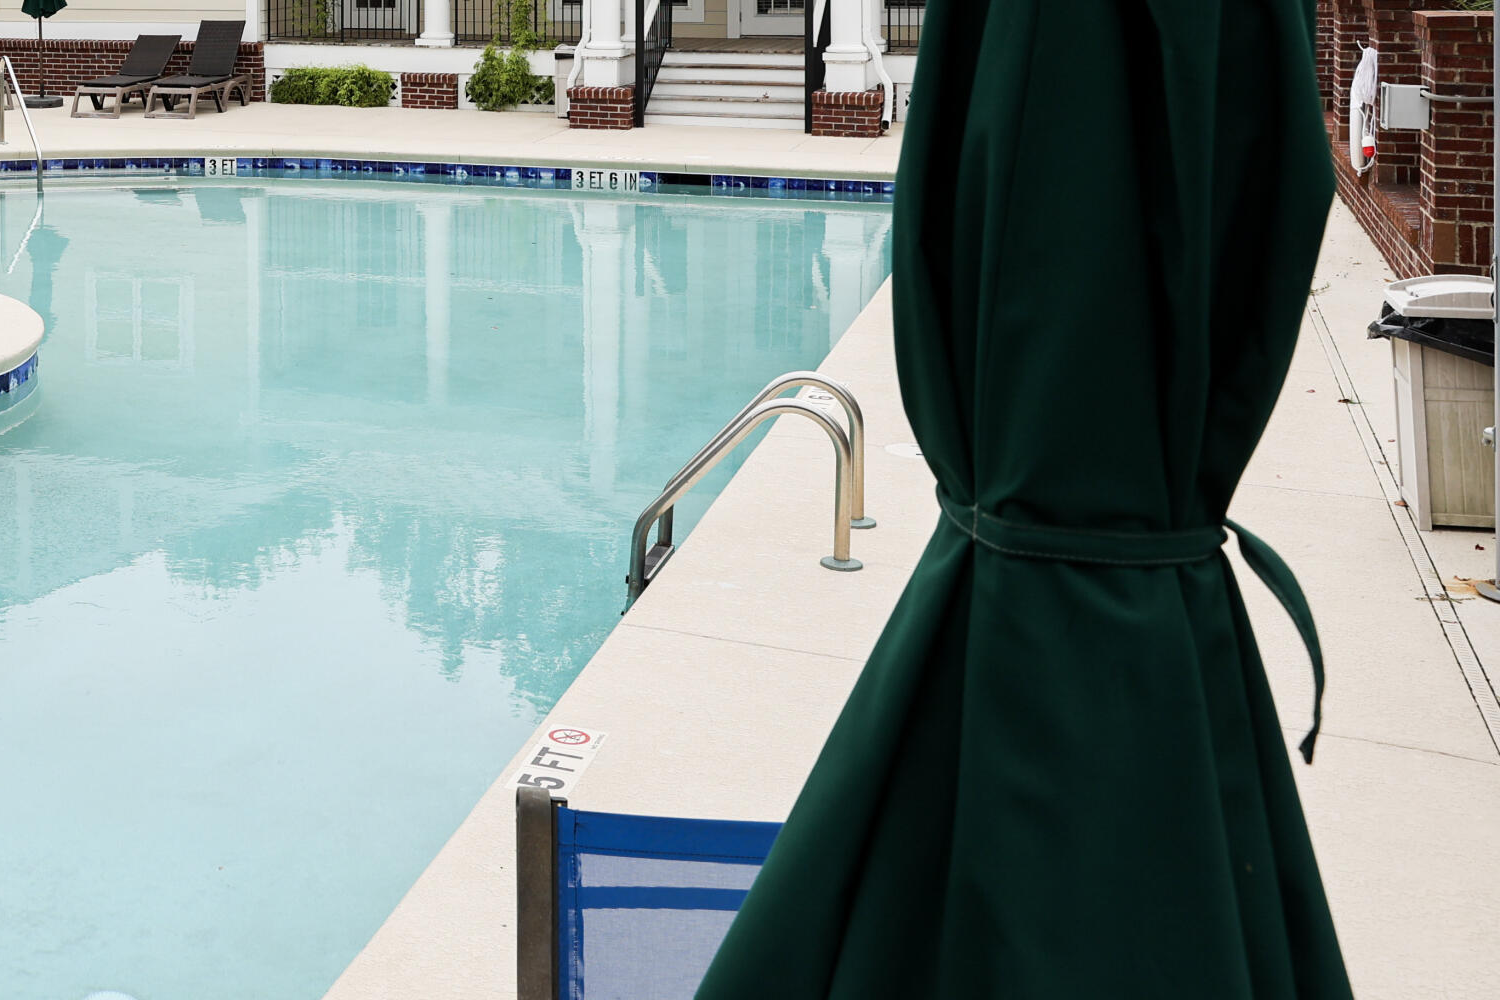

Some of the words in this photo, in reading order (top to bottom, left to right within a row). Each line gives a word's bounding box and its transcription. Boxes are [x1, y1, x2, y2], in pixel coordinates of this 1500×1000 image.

[576, 171, 584, 183] 3
[530, 746, 584, 773] FT
[517, 773, 565, 790] 5
